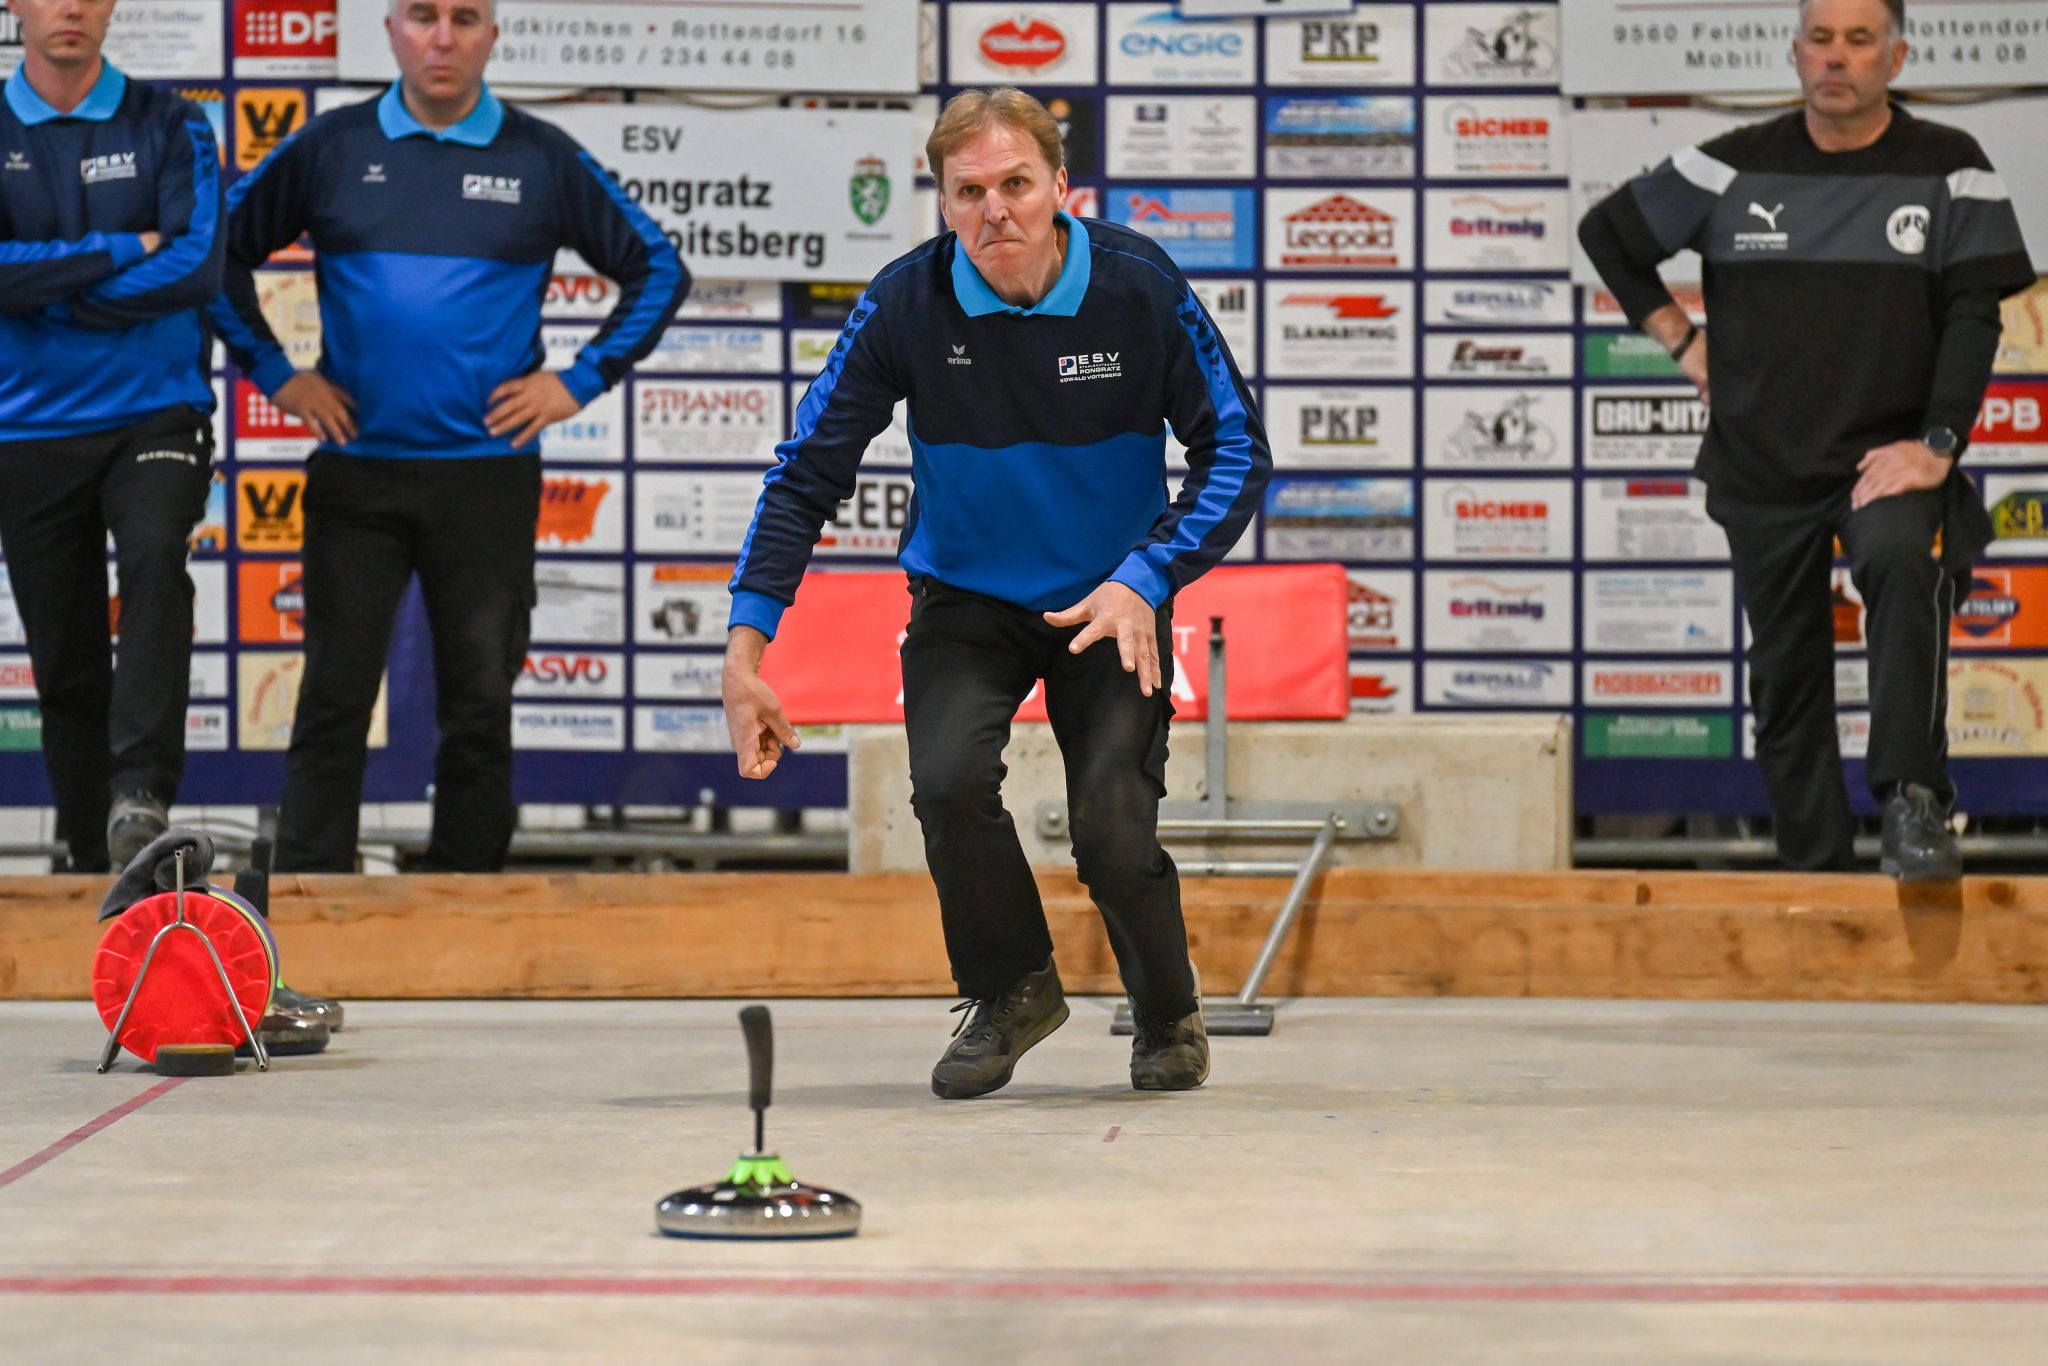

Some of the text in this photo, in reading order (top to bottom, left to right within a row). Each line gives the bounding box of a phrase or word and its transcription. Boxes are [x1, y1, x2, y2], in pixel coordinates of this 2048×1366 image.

[672, 20, 822, 42] Rottendorf
[838, 24, 866, 43] 16
[1302, 21, 1378, 55] PKP
[1613, 23, 1678, 44] 9560
[561, 44, 625, 64] 0650
[661, 46, 706, 67] 234
[722, 49, 750, 66] 44
[764, 49, 795, 69] 08
[1685, 49, 1773, 69] Mobil:
[1950, 45, 1981, 64] 44
[1995, 42, 2027, 65] 08
[1457, 118, 1549, 136] SICHER
[622, 126, 683, 152] ESV
[658, 222, 824, 268] oitsberg
[1286, 220, 1393, 255] Leopold
[947, 357, 972, 365] erima
[1078, 352, 1120, 365] ESV
[1079, 366, 1121, 375] PONGRATZ
[1087, 372, 1122, 381] VOITSBERG
[1301, 405, 1377, 438] PKP
[1456, 501, 1548, 519] SICHER
